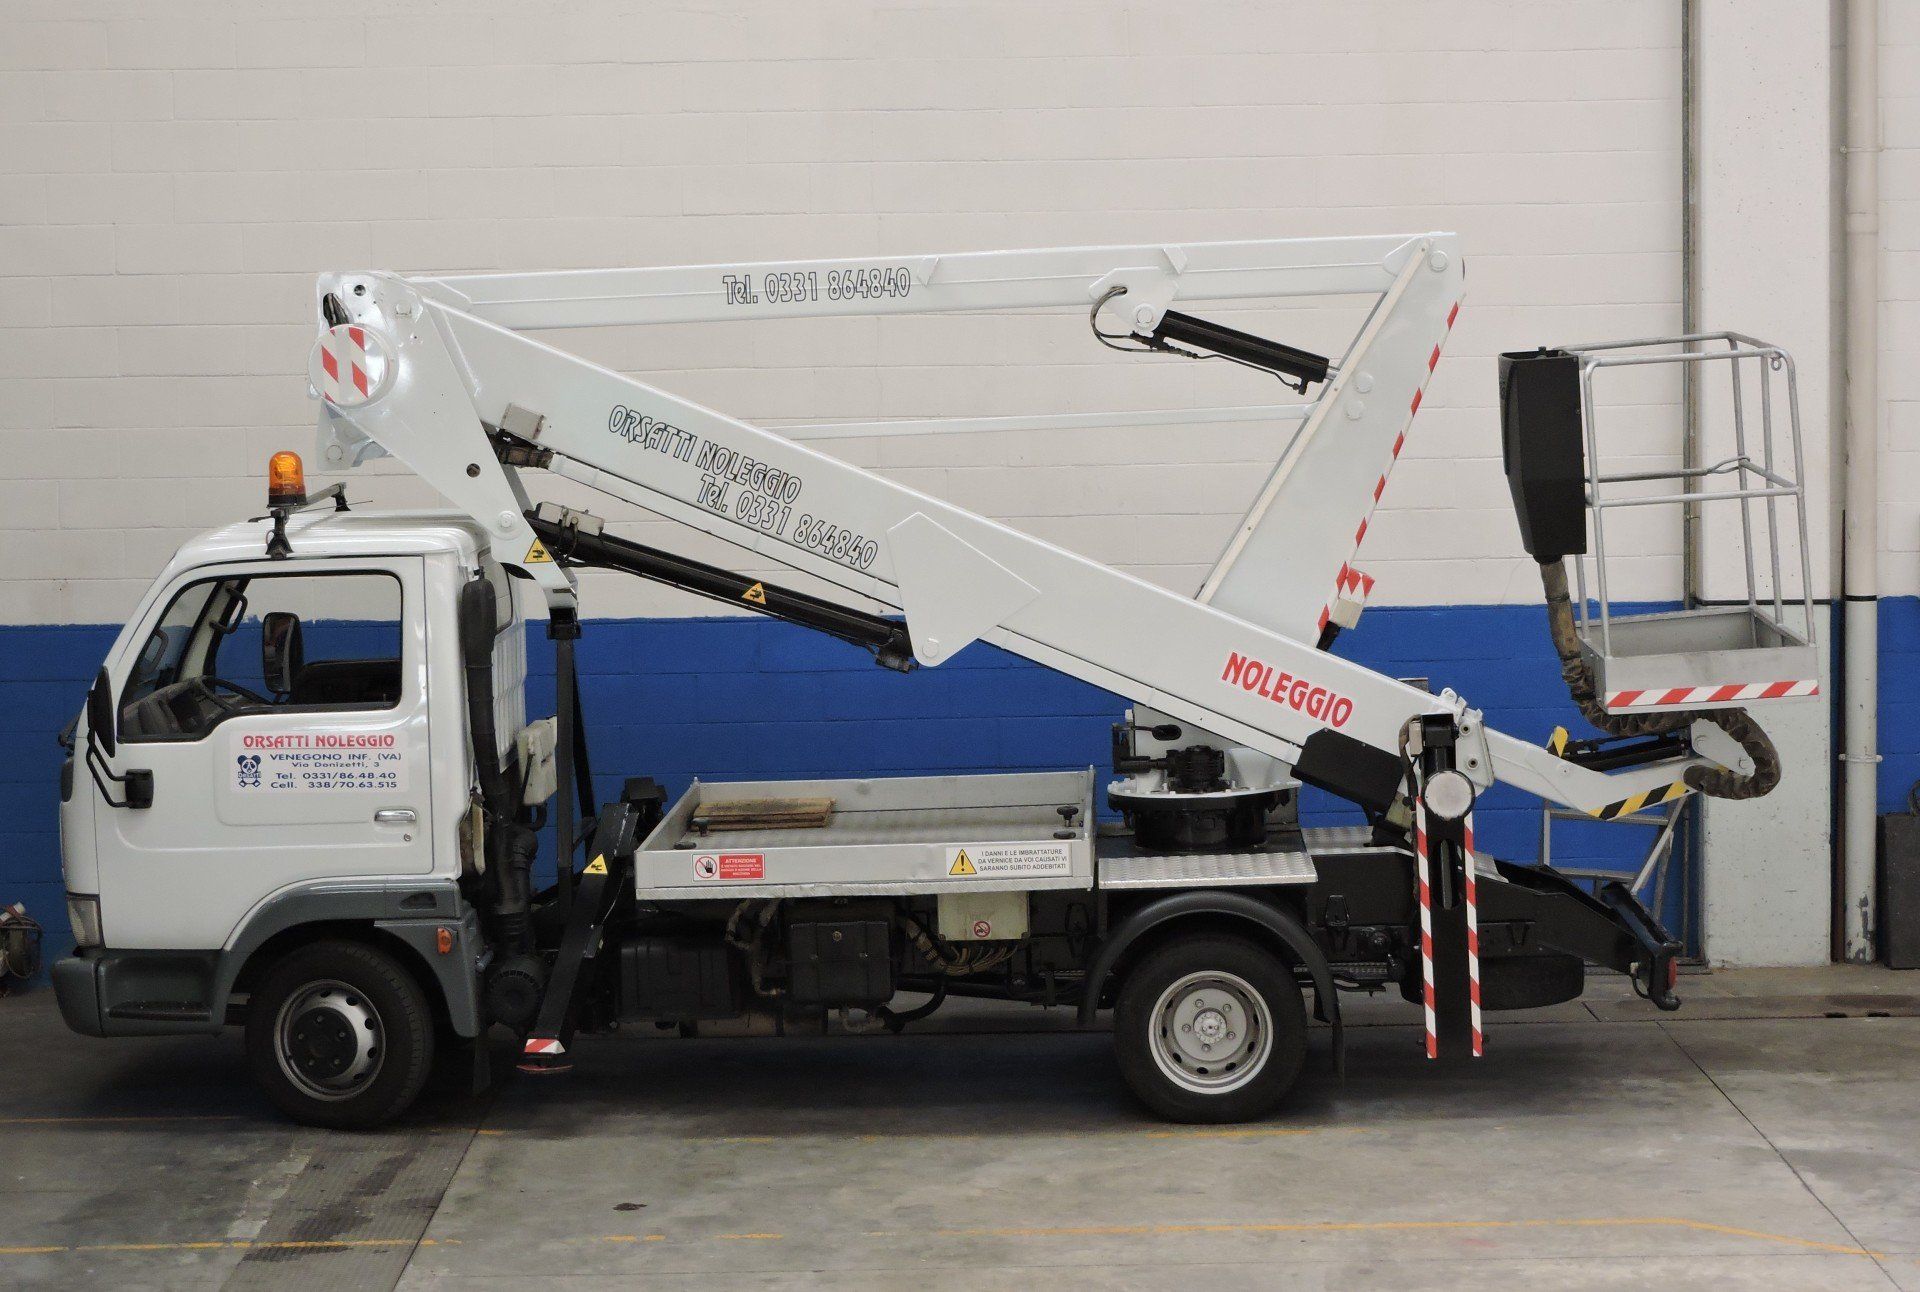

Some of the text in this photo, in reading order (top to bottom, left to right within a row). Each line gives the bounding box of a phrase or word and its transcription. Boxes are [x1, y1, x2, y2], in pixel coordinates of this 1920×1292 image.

[722, 267, 911, 305] Tel. 0331 864840
[608, 404, 802, 505] ORSATTI NOLEGGIO
[697, 474, 879, 570] Tel. 0331 864840
[1221, 651, 1353, 728] NOLEGGIO
[243, 735, 395, 749] ORSATTI NOLEGGIO
[269, 753, 402, 761] VENEGONO INF. (VA)
[270, 781, 397, 789] Cell. 338/70.63.515
[275, 772, 396, 780] Tel. 0331/86.48.40
